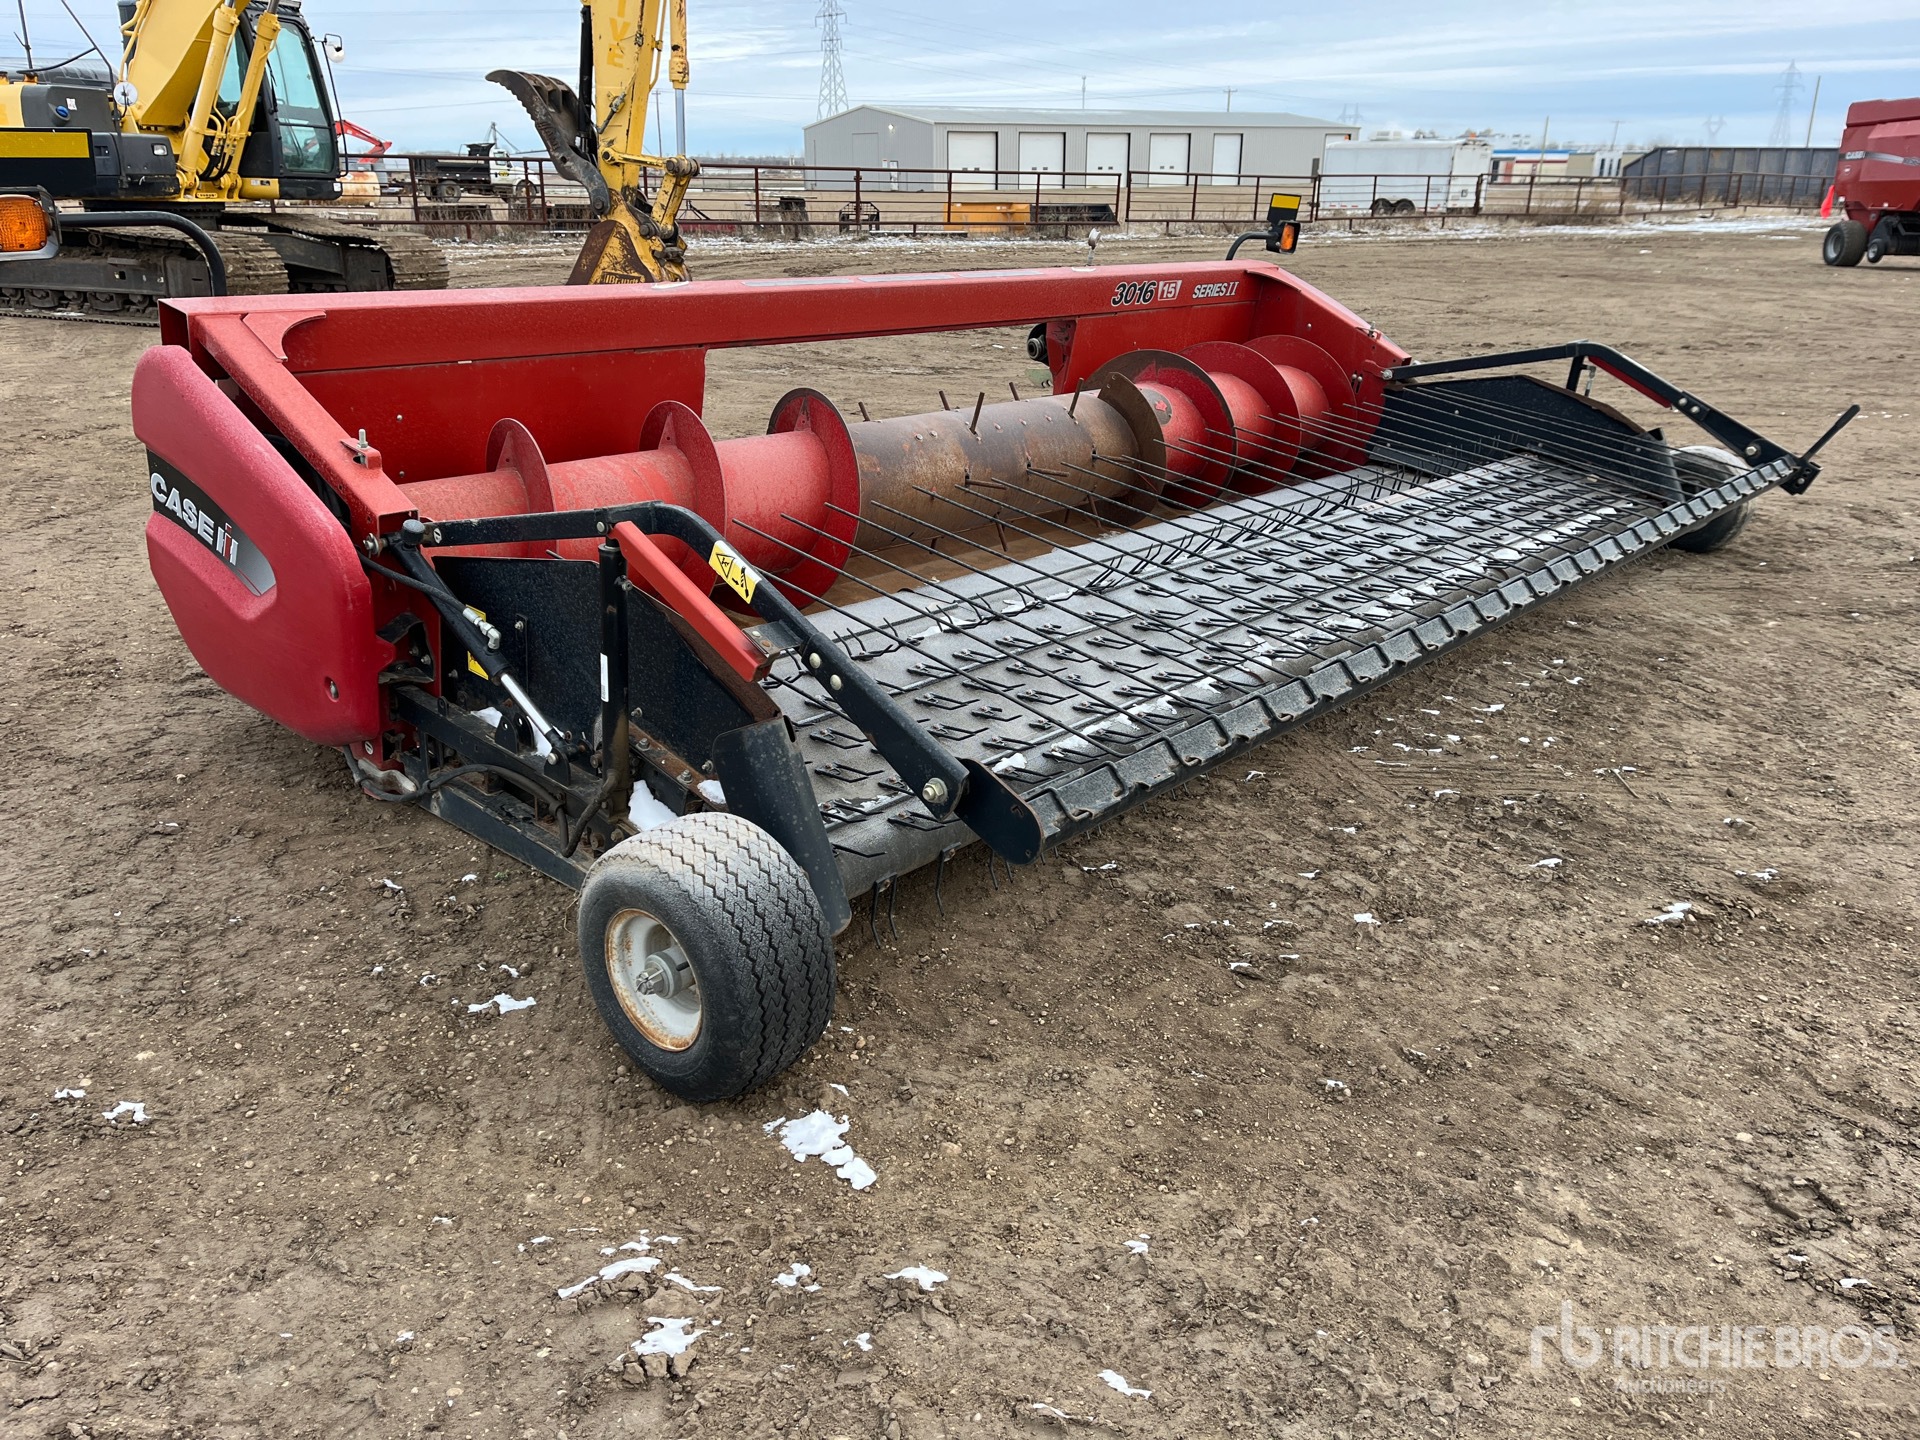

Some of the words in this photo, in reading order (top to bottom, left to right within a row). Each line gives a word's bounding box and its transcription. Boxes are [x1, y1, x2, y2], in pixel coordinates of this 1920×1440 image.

[1110, 280, 1157, 307] 3016
[1163, 283, 1176, 298] 15
[150, 472, 215, 546] CASE
